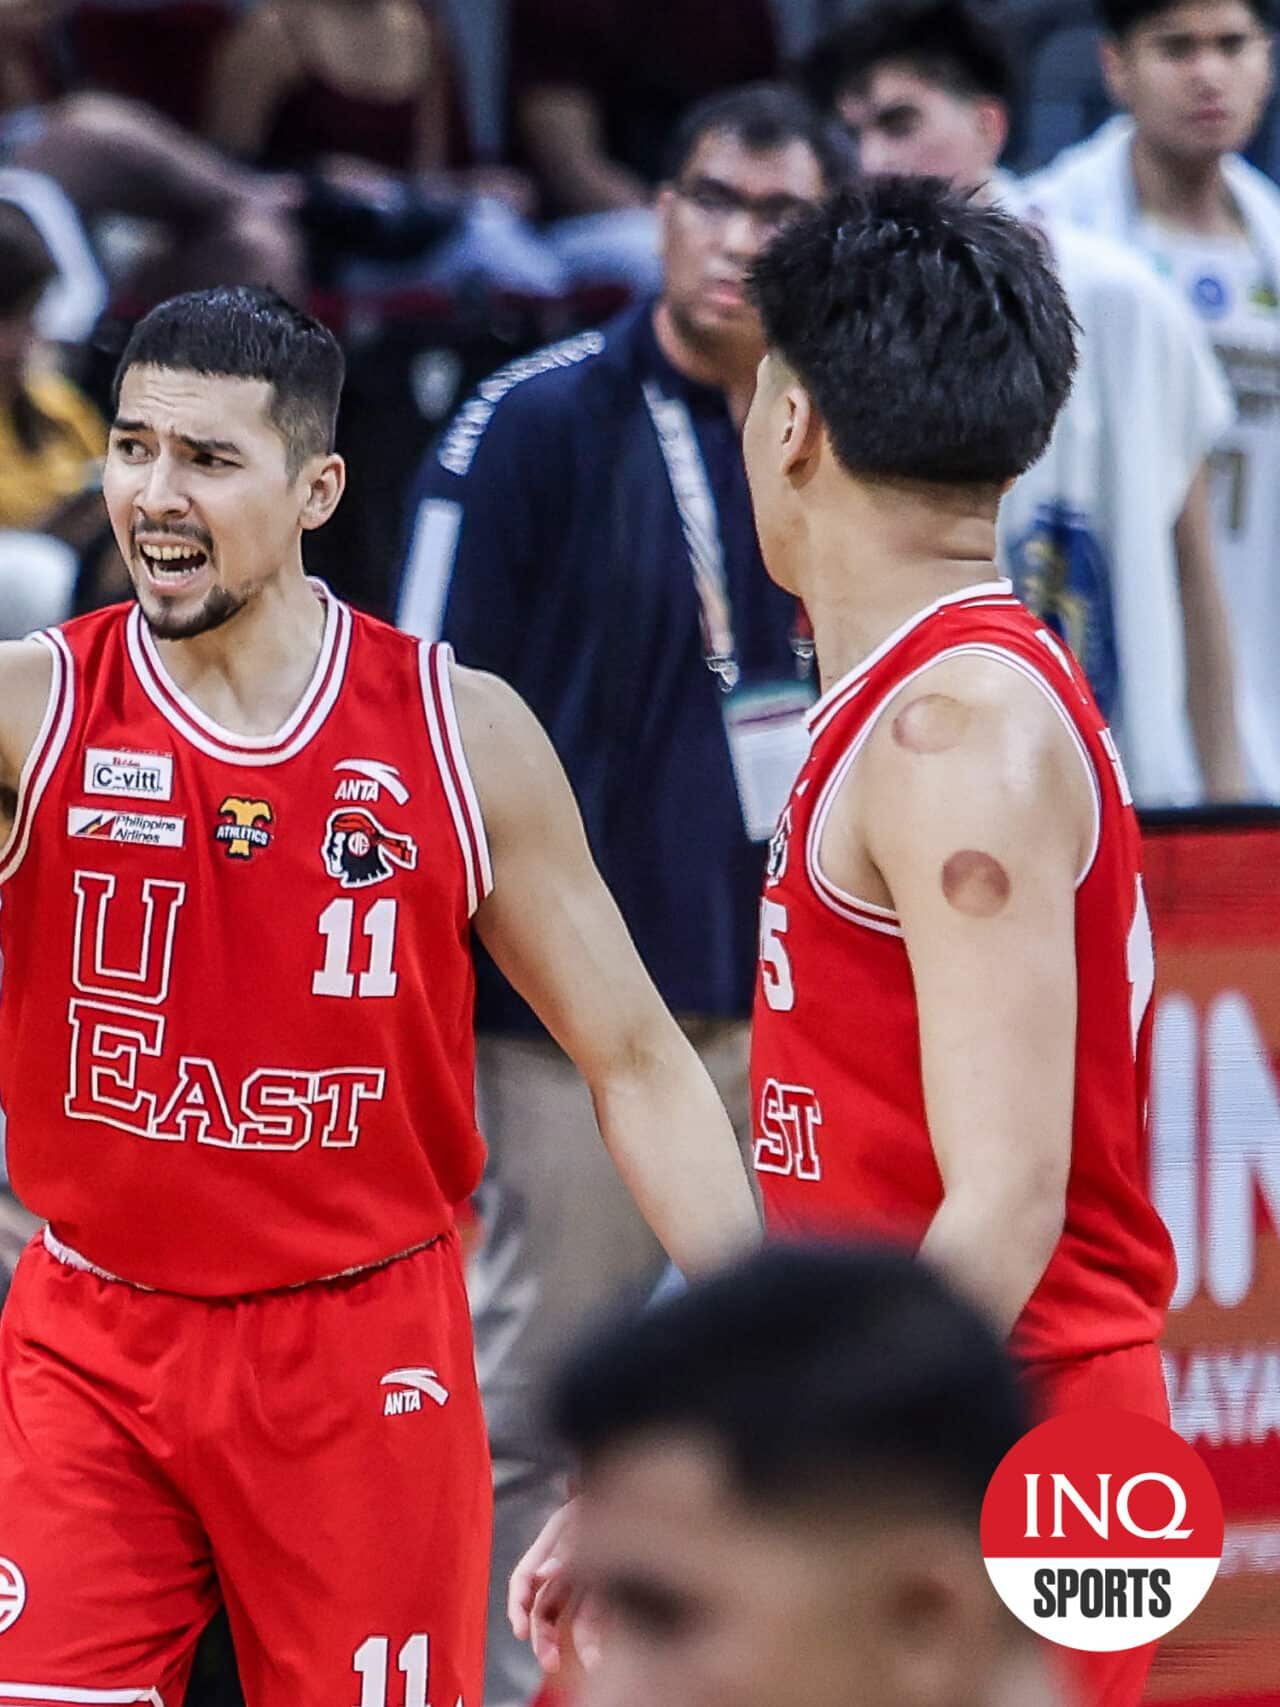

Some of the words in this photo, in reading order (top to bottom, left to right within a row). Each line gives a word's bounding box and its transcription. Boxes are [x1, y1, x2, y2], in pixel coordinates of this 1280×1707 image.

[95, 766, 157, 790] C-vitt
[334, 778, 380, 802] ANTA
[113, 828, 161, 844] Airlines
[114, 815, 177, 832] Philippine
[216, 822, 269, 846] ATHLETICS
[72, 869, 186, 1006] U
[311, 897, 398, 998] 11
[64, 997, 387, 1152] EAST
[753, 1077, 823, 1182] ST
[383, 1388, 422, 1416] ANTA
[353, 1633, 431, 1707] 11
